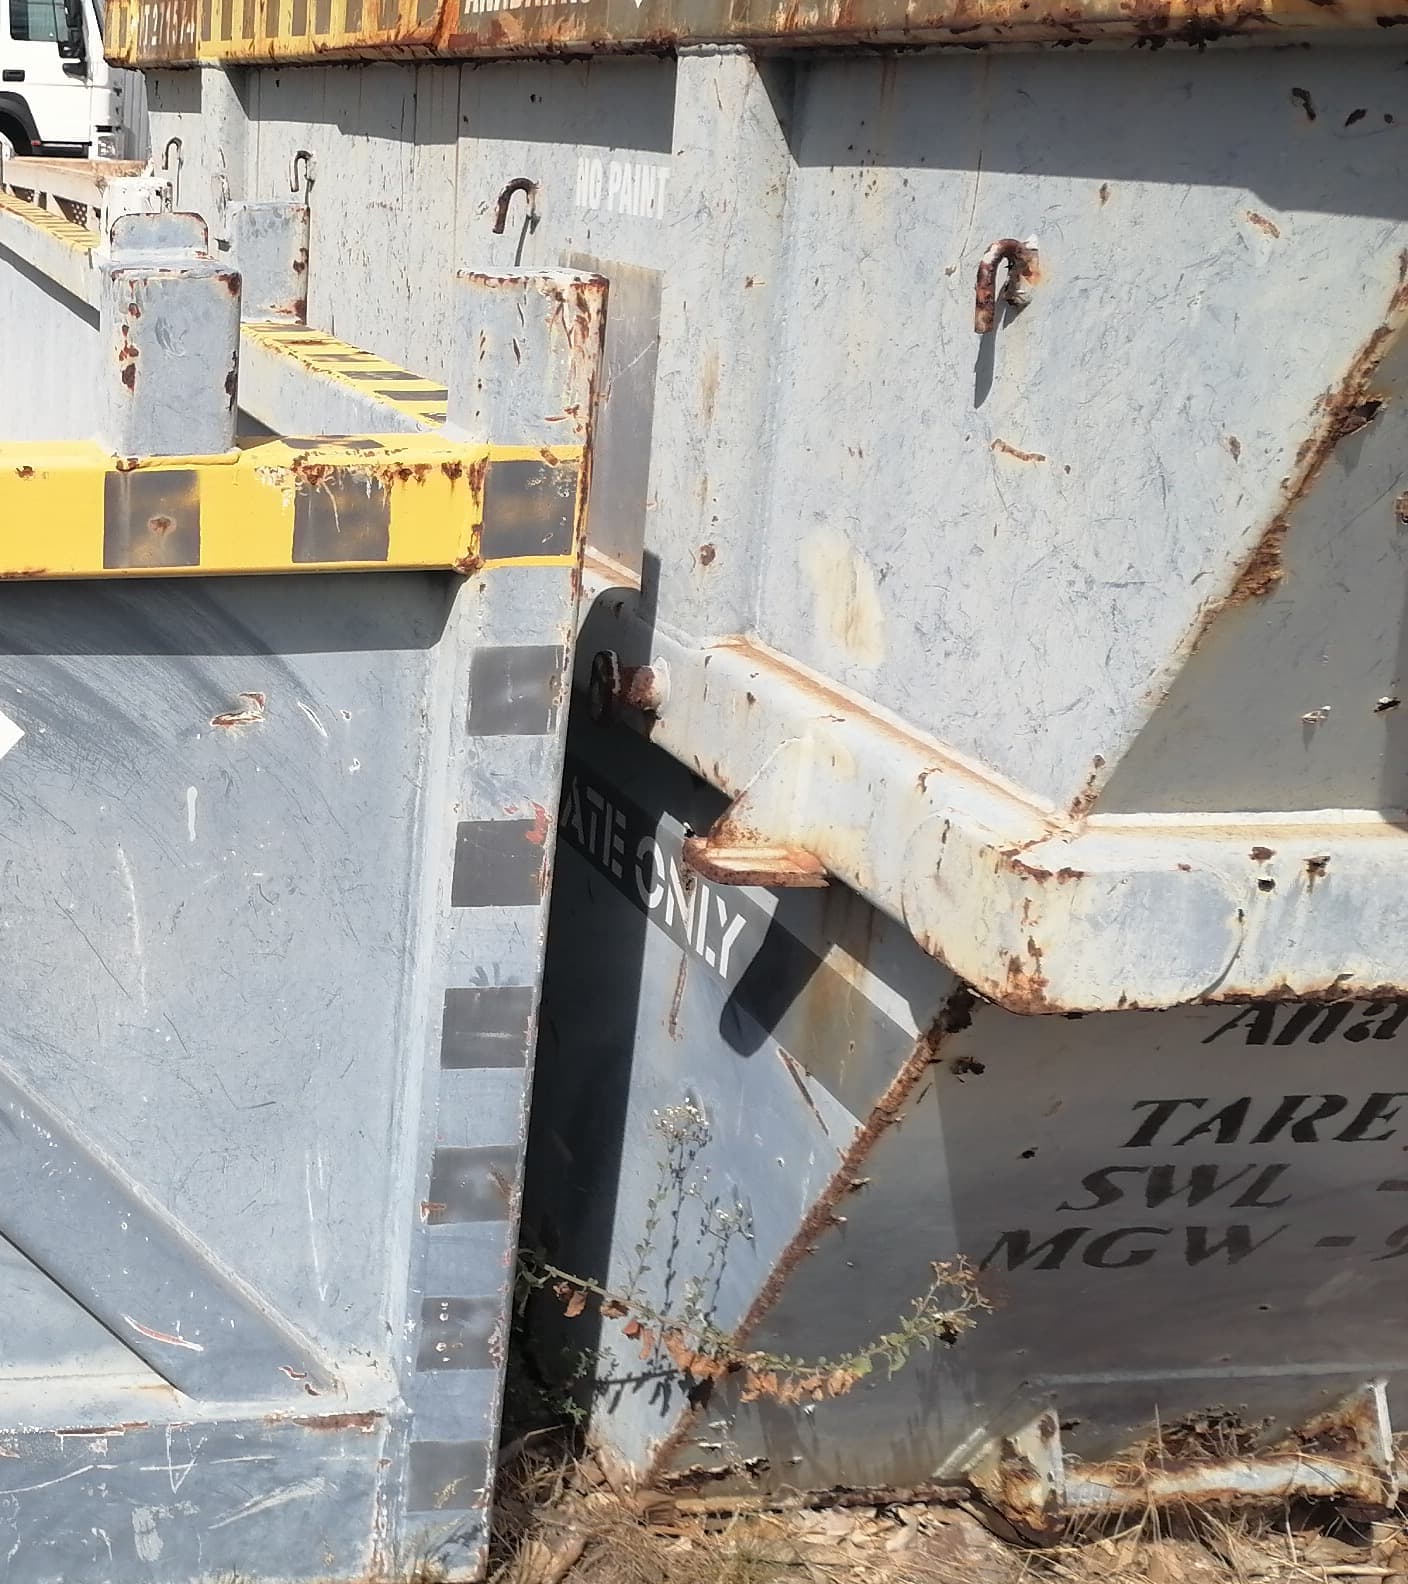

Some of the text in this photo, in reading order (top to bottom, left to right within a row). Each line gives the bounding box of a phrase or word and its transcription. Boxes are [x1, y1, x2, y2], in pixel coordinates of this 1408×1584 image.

[576, 156, 671, 220] NO PAINT
[635, 835, 748, 980] ONLY
[1120, 1092, 1408, 1148] TARE
[1055, 1163, 1293, 1211] SWL
[980, 1224, 1292, 1272] MGW
